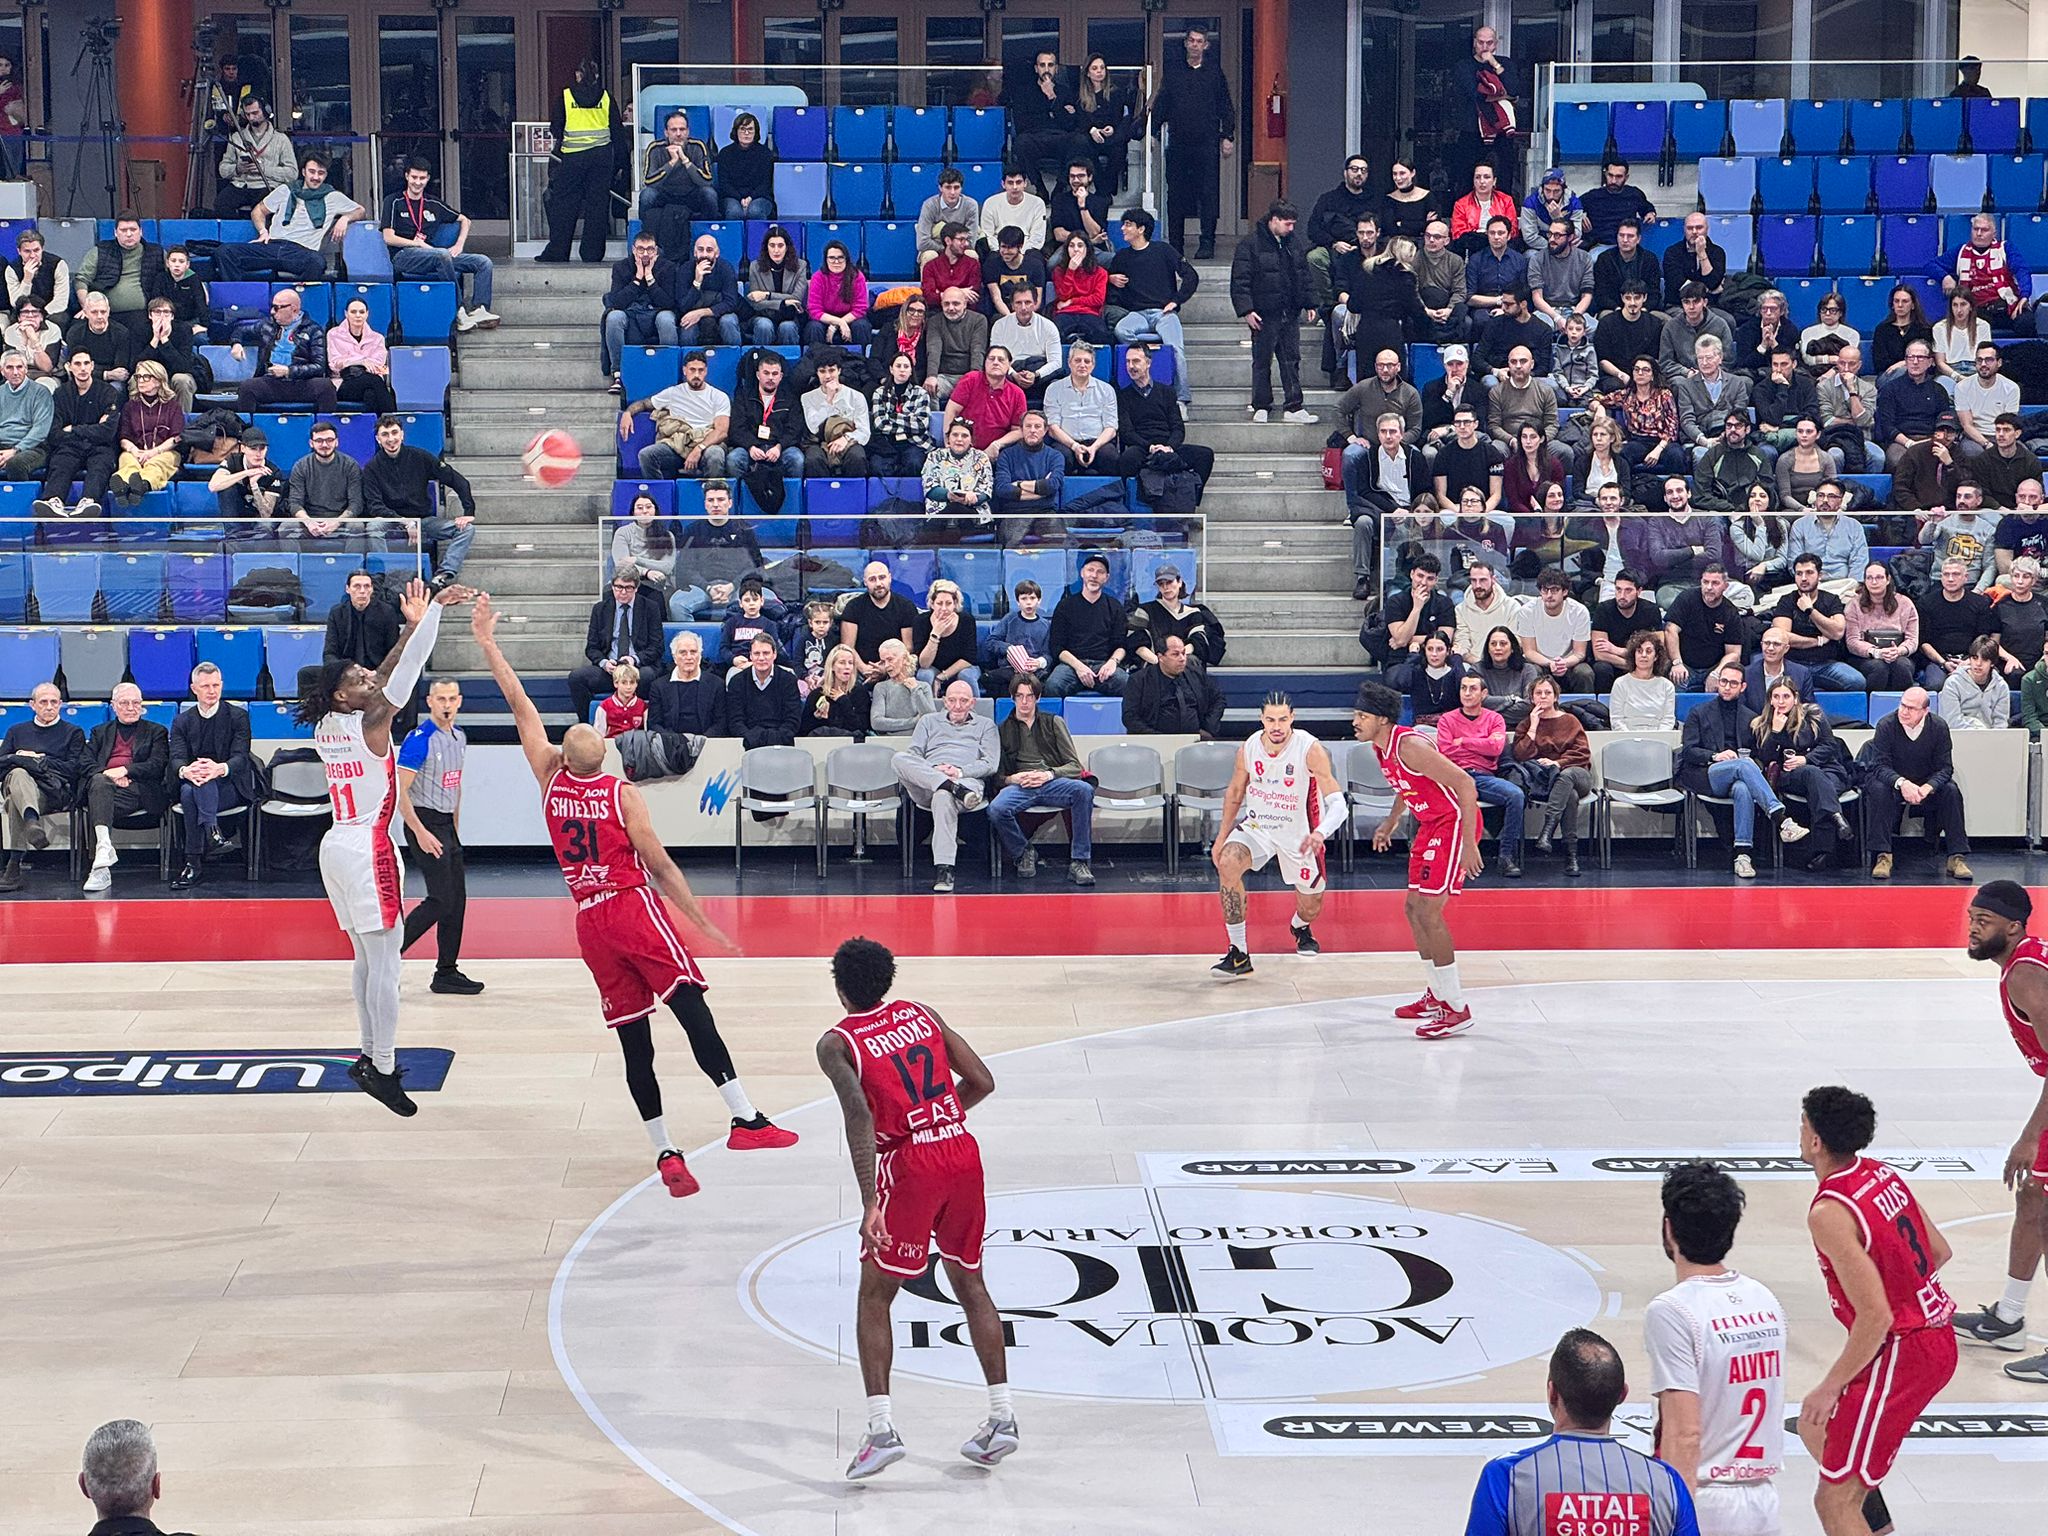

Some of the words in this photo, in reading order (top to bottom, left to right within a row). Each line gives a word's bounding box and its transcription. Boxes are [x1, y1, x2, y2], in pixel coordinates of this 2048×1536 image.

[1255, 760, 1265, 776] 8
[329, 783, 358, 821] 11
[582, 788, 609, 799] AON
[550, 797, 609, 820] SHIELDS
[560, 819, 600, 864] 31
[1300, 867, 1311, 881] 8
[891, 1006, 919, 1024] AON
[863, 1015, 933, 1058] BROOKS
[890, 1044, 947, 1106] 12
[1196, 1162, 1403, 1172] EYEWEAR
[1427, 1161, 1558, 1174] EA7
[1607, 1159, 1814, 1170] EYEAR
[1872, 1181, 1909, 1222] ELLIS
[983, 1228, 1147, 1242] ARMA
[1169, 1225, 1429, 1240] GIORGIO
[1896, 1215, 1928, 1277] 3
[1055, 1316, 1475, 1347] ACQUA
[1728, 1350, 1780, 1384] ALVITI
[1283, 1420, 1541, 1434] EYEWEAR
[1734, 1388, 1766, 1459] 2
[1909, 1420, 2048, 1432] EYEW
[1557, 1495, 1640, 1520] ATTAL
[1556, 1521, 1640, 1536] GROUP
